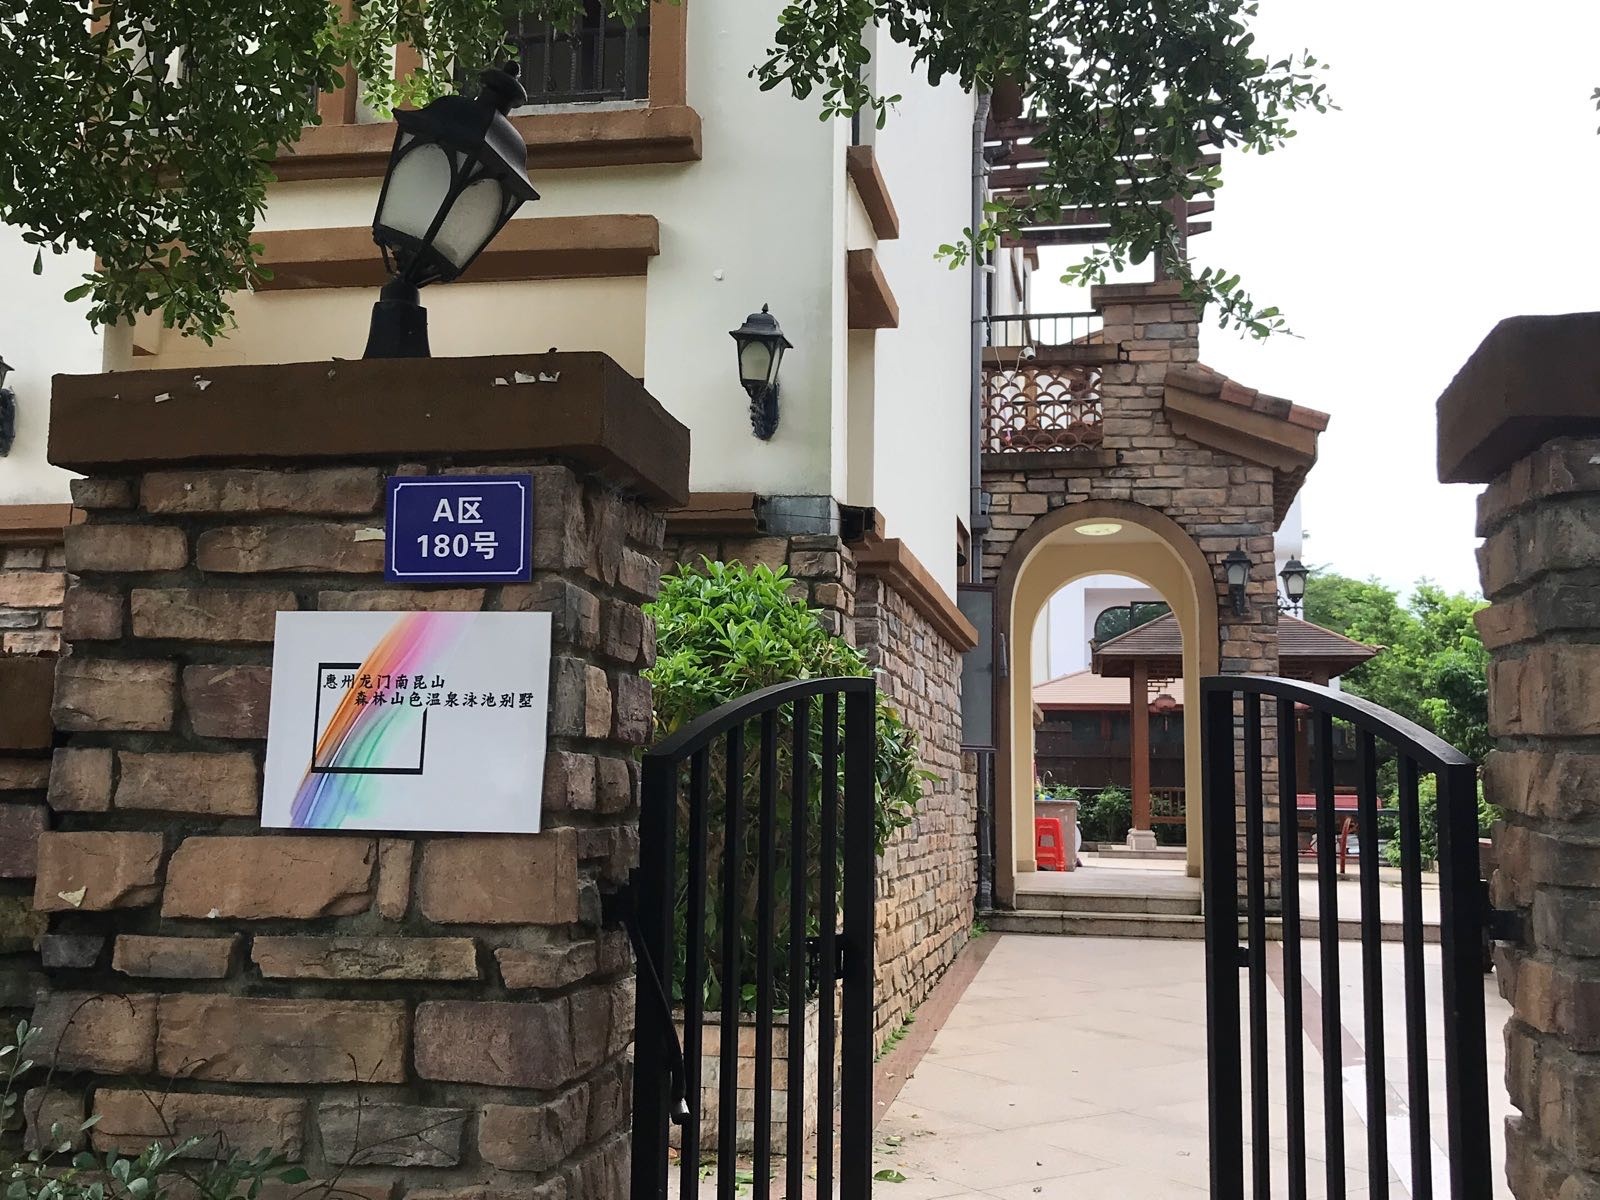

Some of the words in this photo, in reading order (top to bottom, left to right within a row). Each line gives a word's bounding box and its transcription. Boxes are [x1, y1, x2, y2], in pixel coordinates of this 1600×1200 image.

[432, 496, 484, 524] A区
[416, 532, 499, 560] 180号
[322, 673, 446, 690] 惠州龙门南昆山
[354, 691, 535, 709] 森林山色温泉泳池别墅
